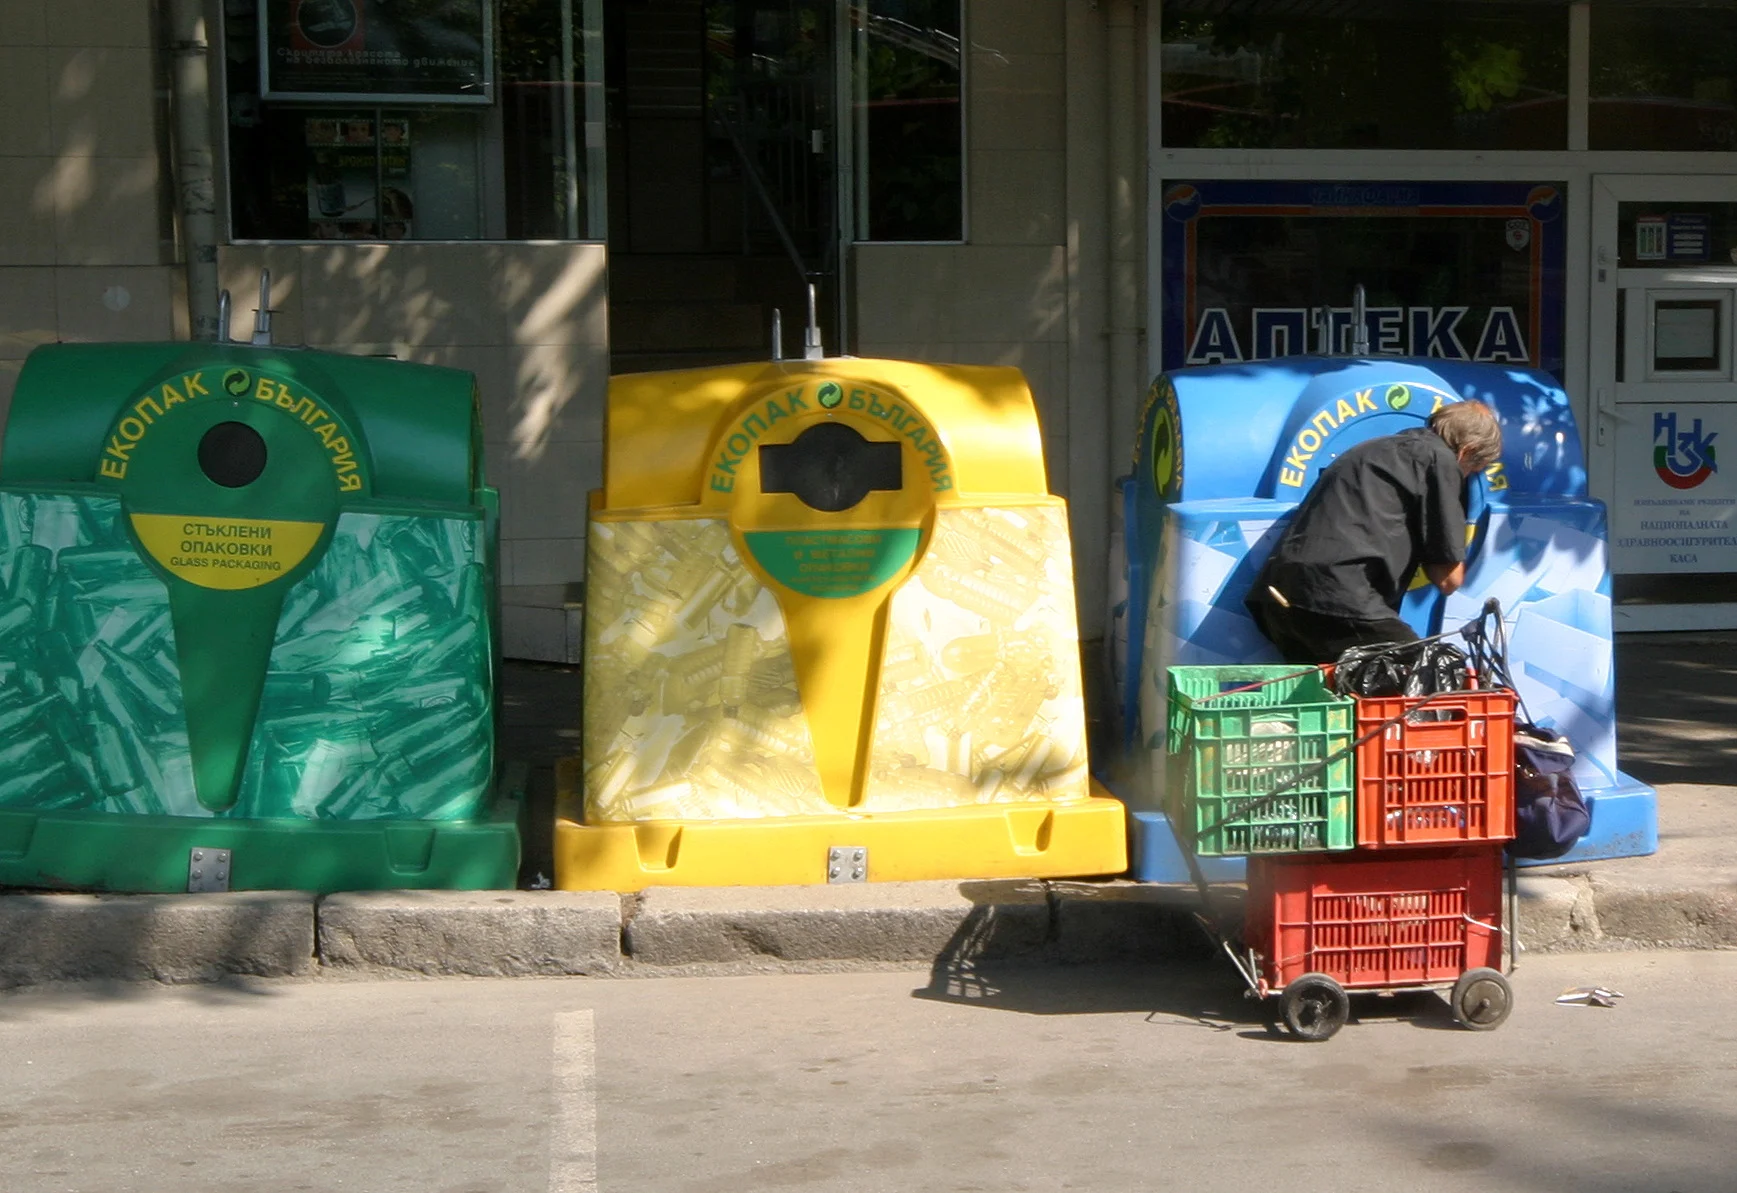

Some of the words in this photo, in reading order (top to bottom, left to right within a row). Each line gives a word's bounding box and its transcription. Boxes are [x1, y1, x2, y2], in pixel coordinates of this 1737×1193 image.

[1187, 306, 1529, 363] АПТЕКА
[101, 372, 209, 479] ЕКОПАК
[255, 377, 362, 492] БЪЛГАРИЯ
[710, 387, 808, 494] ЕКОПАК
[848, 389, 953, 493] БЪЛГАРИЯ
[1280, 388, 1378, 488] ЕКОПАК
[180, 540, 273, 557] ОПАКОВКИ
[183, 523, 272, 539] СТЪКЛЕНИ
[170, 556, 209, 568] GLASS
[212, 558, 281, 571] PACKAGING
[1670, 553, 1698, 564] КАСА
